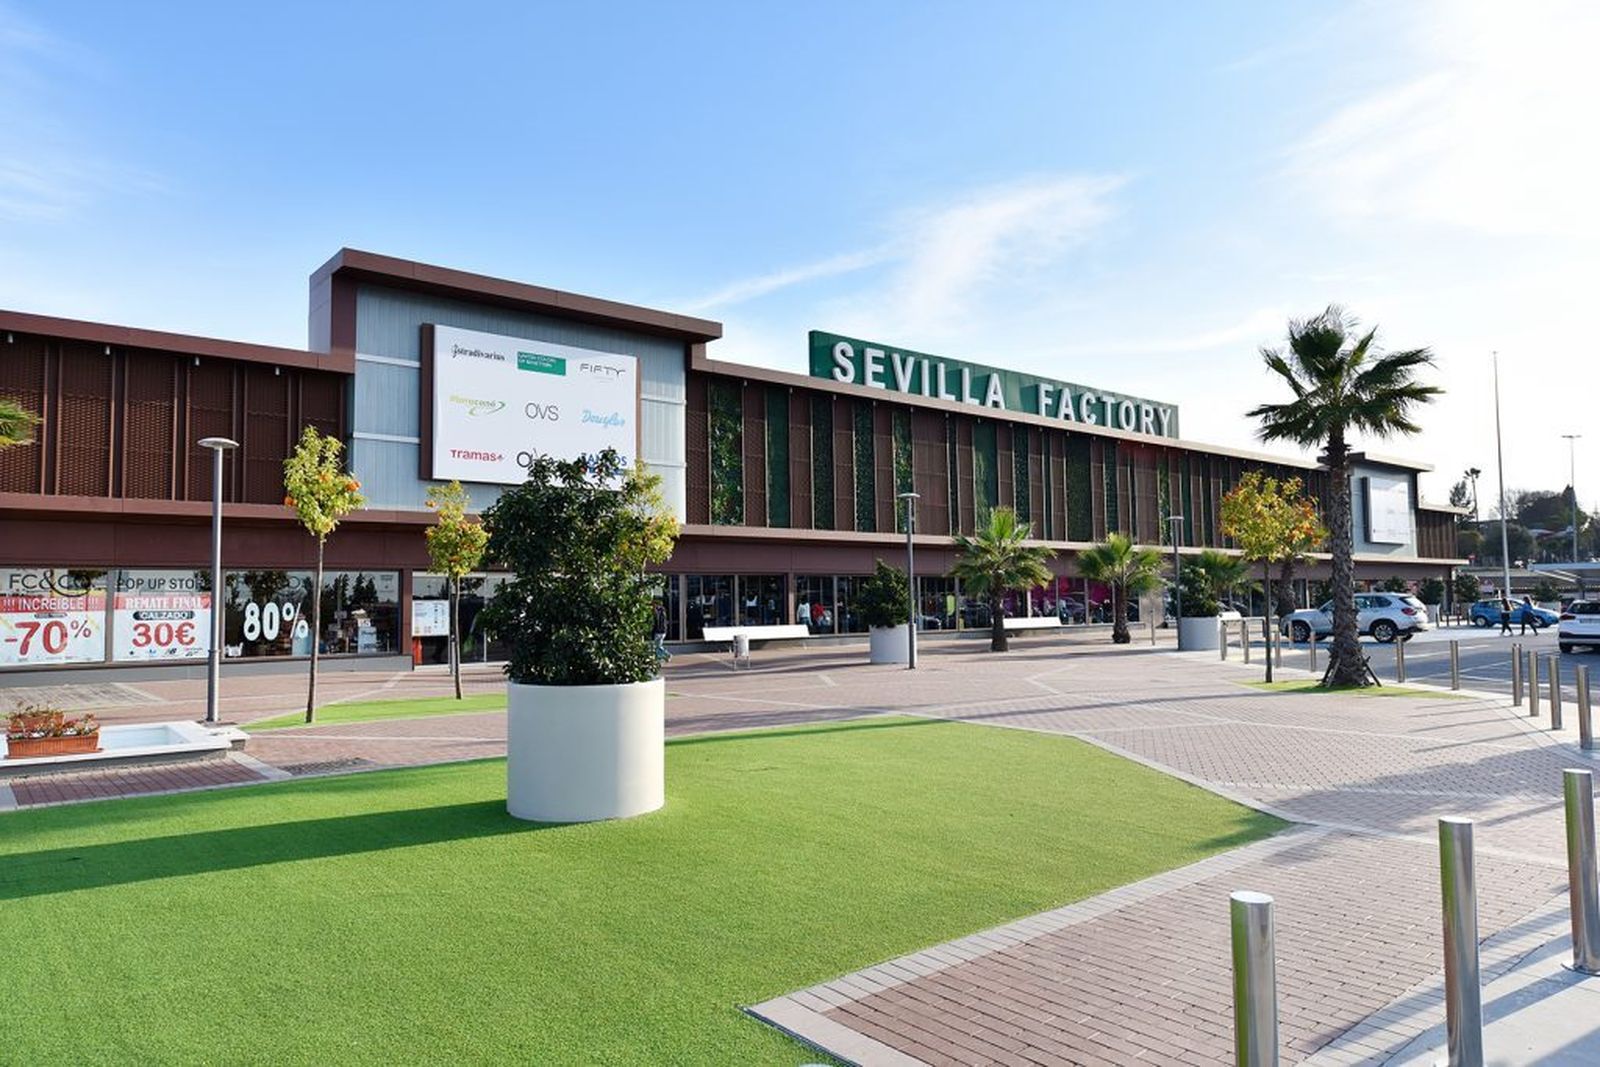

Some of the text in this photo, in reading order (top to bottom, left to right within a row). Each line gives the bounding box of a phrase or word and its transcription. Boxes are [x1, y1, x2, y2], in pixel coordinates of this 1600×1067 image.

[580, 363, 626, 378] FIFTY
[832, 341, 1173, 438] SEVILLA FACTORY
[525, 402, 559, 422] OVS
[117, 578, 144, 590] POP
[148, 578, 166, 590] UP
[125, 596, 201, 609] REMATE FINAL
[140, 611, 189, 620] CALZADO
[243, 602, 309, 641] 80%
[132, 621, 196, 648] 30€
